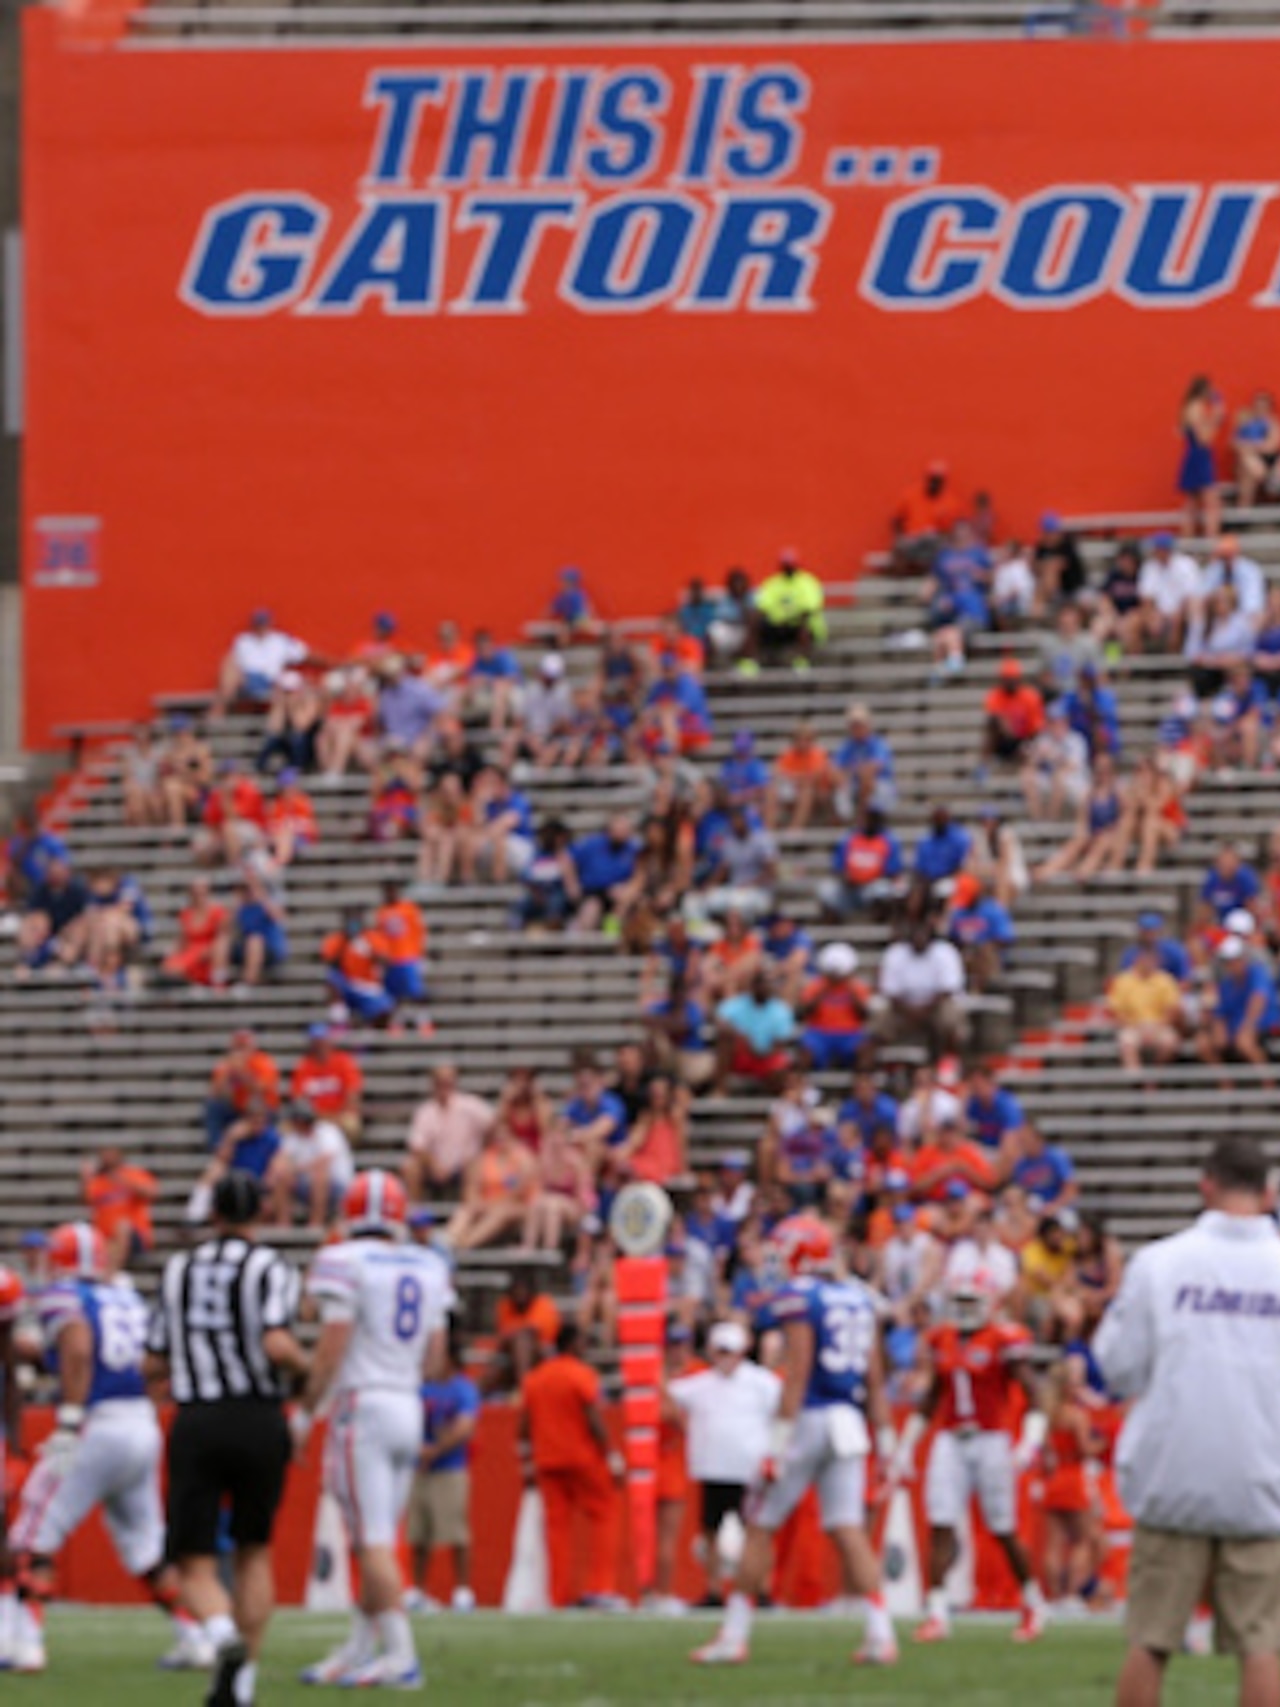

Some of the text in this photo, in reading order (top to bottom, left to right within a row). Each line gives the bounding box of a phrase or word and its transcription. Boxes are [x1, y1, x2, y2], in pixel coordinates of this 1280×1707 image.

[359, 65, 672, 189] THIS
[667, 63, 811, 189] IS
[177, 186, 832, 316] GATOR
[394, 1273, 422, 1342] 8
[953, 1366, 974, 1417] 1
